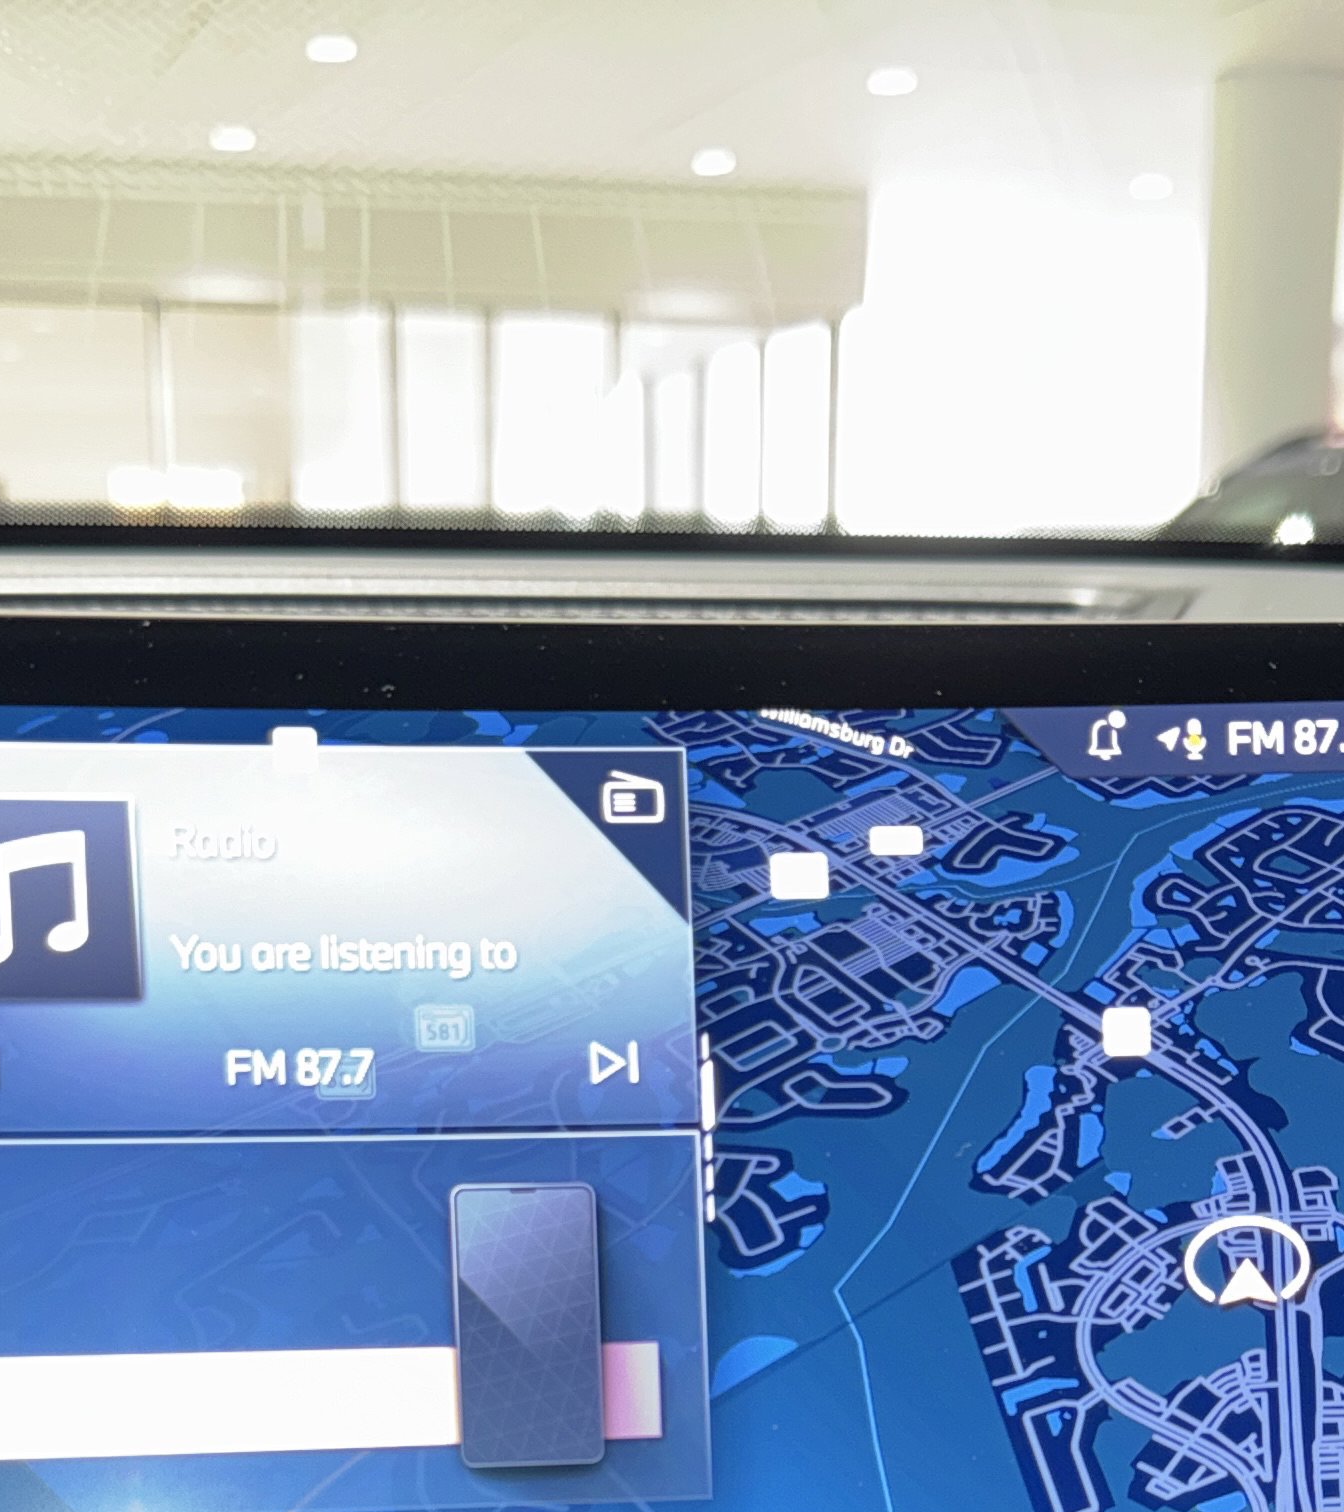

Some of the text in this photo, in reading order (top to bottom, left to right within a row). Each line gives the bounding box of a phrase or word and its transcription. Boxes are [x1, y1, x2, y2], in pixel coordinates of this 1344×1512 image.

[888, 735, 915, 759] Dr
[1228, 720, 1285, 756] FM
[169, 824, 279, 861] Radio
[168, 933, 519, 980] You are listening to
[426, 1022, 460, 1042] 581
[225, 1047, 288, 1087] FM
[296, 1046, 376, 1087] 87.7
